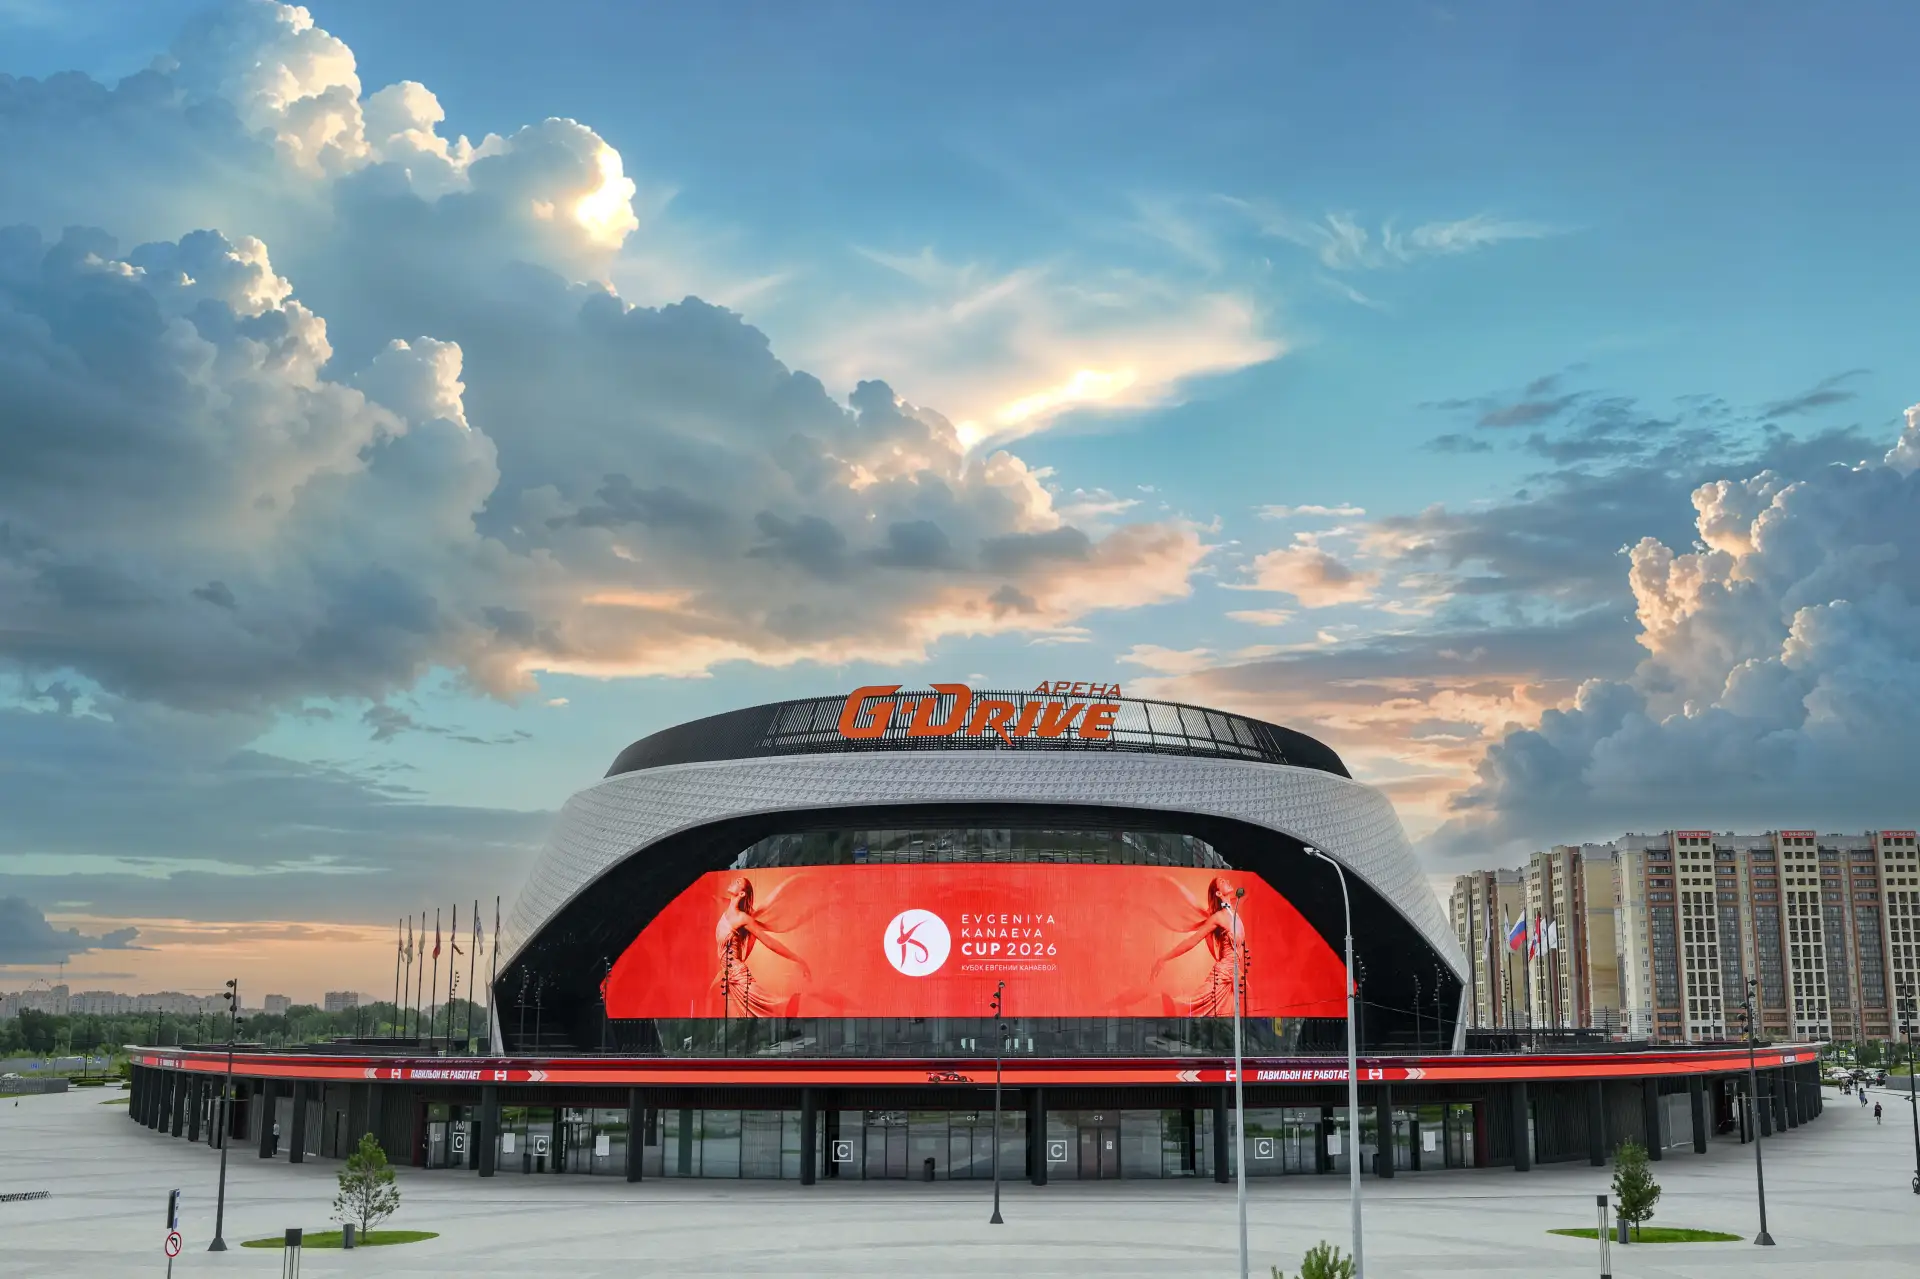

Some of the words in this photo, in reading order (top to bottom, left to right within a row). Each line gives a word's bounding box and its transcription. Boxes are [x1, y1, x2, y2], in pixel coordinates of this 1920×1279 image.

[1034, 680, 1121, 697] АРЕНА
[961, 914, 1055, 924] EVGENIYA
[961, 928, 1043, 938] KANAEVA
[961, 943, 1001, 956] CUP
[1006, 943, 1057, 956] 2026
[961, 964, 984, 972] КУБОК
[985, 964, 1018, 972] ЕВГЕНИИ
[1019, 963, 1058, 972] КАНАЕВОЙ
[410, 1069, 441, 1080] ПАВИЛЬОН
[441, 1070, 450, 1080] НЕ
[449, 1070, 482, 1080] РАБОТАЕТ
[1257, 1069, 1301, 1080] ПАВИЛЬОН
[1301, 1070, 1314, 1080] НЕ
